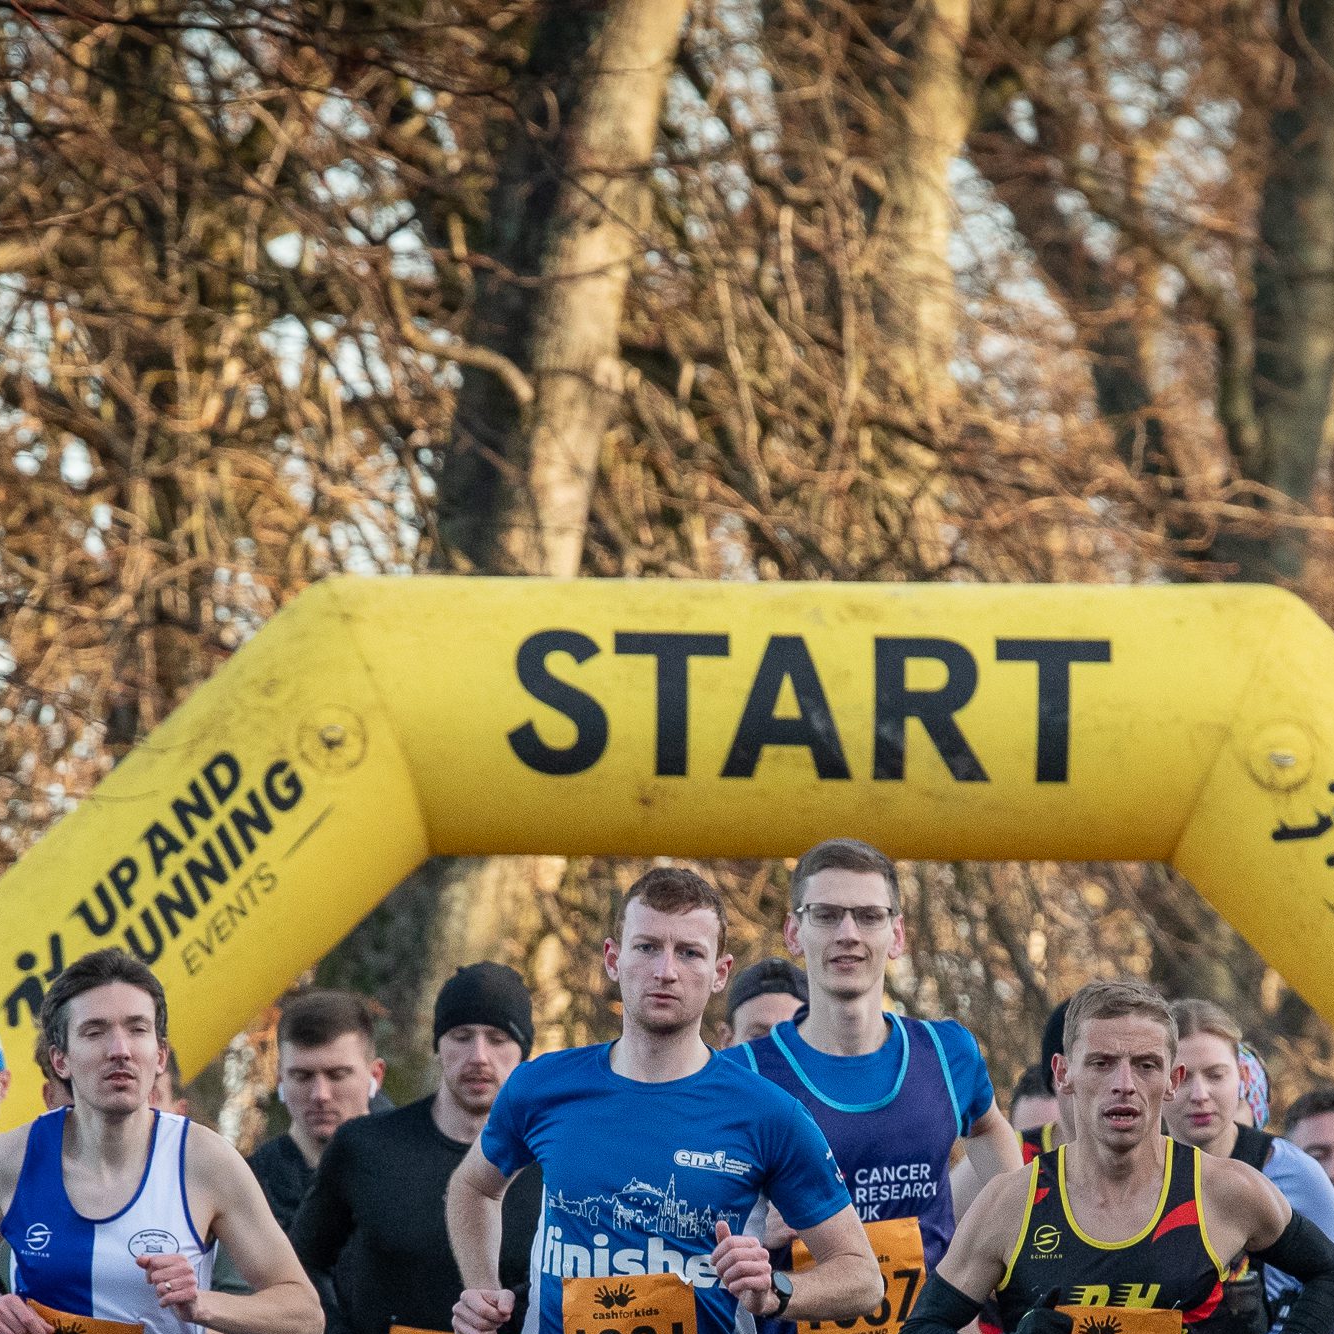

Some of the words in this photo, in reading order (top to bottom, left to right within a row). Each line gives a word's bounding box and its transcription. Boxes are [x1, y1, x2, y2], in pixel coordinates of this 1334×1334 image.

[507, 629, 1112, 783] START
[71, 857, 140, 937] UP
[140, 751, 242, 877] AND
[123, 760, 304, 966] UNNING
[181, 862, 278, 977] EVENTS
[674, 1149, 725, 1172] emf
[855, 1163, 931, 1185] CANCER
[857, 1204, 881, 1221] UK
[593, 1307, 659, 1320] cashforkids
